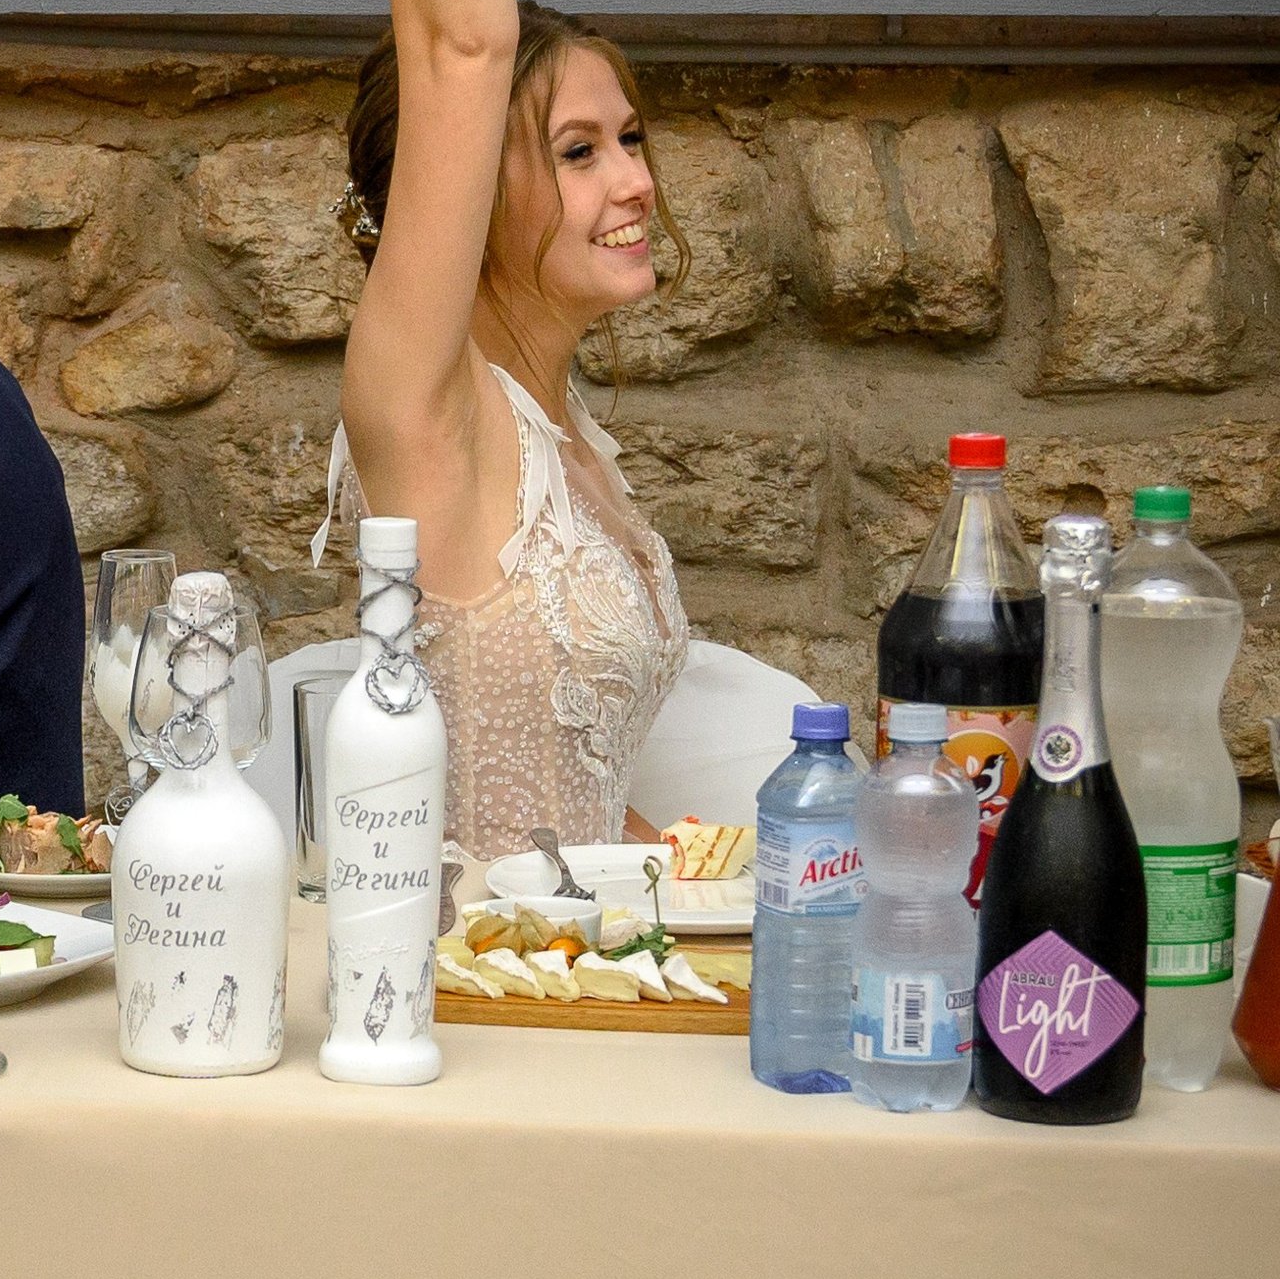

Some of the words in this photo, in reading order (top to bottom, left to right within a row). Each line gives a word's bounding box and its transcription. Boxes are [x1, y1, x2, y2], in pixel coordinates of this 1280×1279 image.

[334, 795, 429, 831] Сергей
[372, 840, 389, 859] и
[128, 859, 225, 895] Сергей
[330, 857, 431, 892] Регина
[165, 900, 183, 919] и
[124, 912, 227, 948] Регина
[1011, 972, 1057, 987] ABRAU
[998, 962, 1112, 1079] Light
